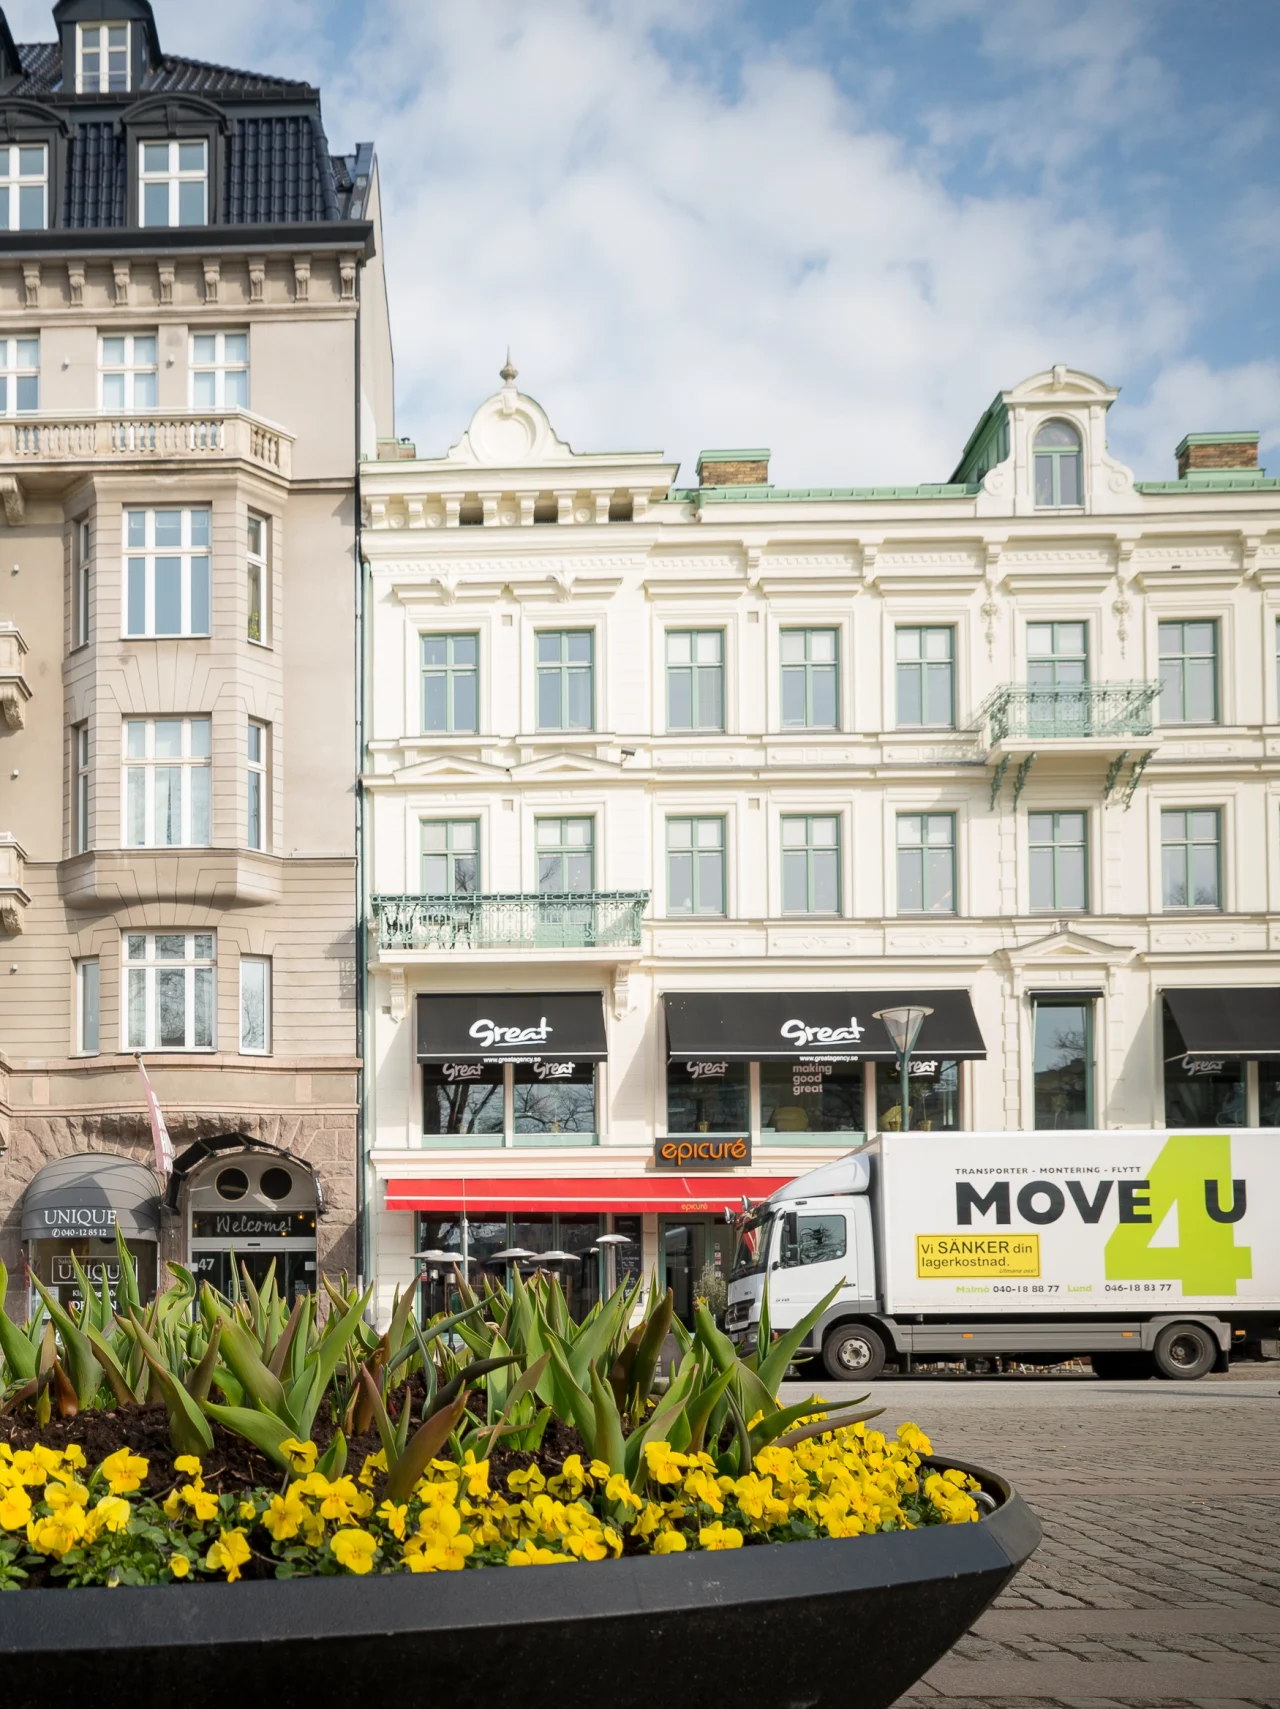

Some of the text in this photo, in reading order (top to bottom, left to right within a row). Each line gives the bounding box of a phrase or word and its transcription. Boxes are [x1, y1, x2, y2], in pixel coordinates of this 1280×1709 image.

[469, 1016, 554, 1047] Great
[780, 1017, 865, 1046] Great
[483, 1056, 542, 1064] www.greatagency.se
[1182, 1056, 1225, 1076] Great
[442, 1063, 484, 1081] Great
[533, 1062, 575, 1080] Great
[686, 1061, 729, 1078] Great
[792, 1063, 832, 1075] making
[792, 1073, 822, 1085] good
[792, 1084, 823, 1096] great
[661, 1138, 747, 1166] epicuré
[955, 1167, 1029, 1175] TRANSPORTER
[1039, 1166, 1101, 1174] MONTERING
[44, 1208, 117, 1226] UNIQUE
[216, 1215, 292, 1232] Welcome!
[955, 1135, 1252, 1296] MOVE 4 U
[88, 1228, 98, 1236] 85
[99, 1228, 107, 1236] 12
[921, 1238, 1033, 1254] Vi SÄNKER din
[198, 1258, 215, 1270] 47
[921, 1256, 1010, 1269] lagerkostnad.
[956, 1284, 1060, 1293] Malmö 040-18 88 77
[1067, 1283, 1172, 1293] Lund 046-18 83 77
